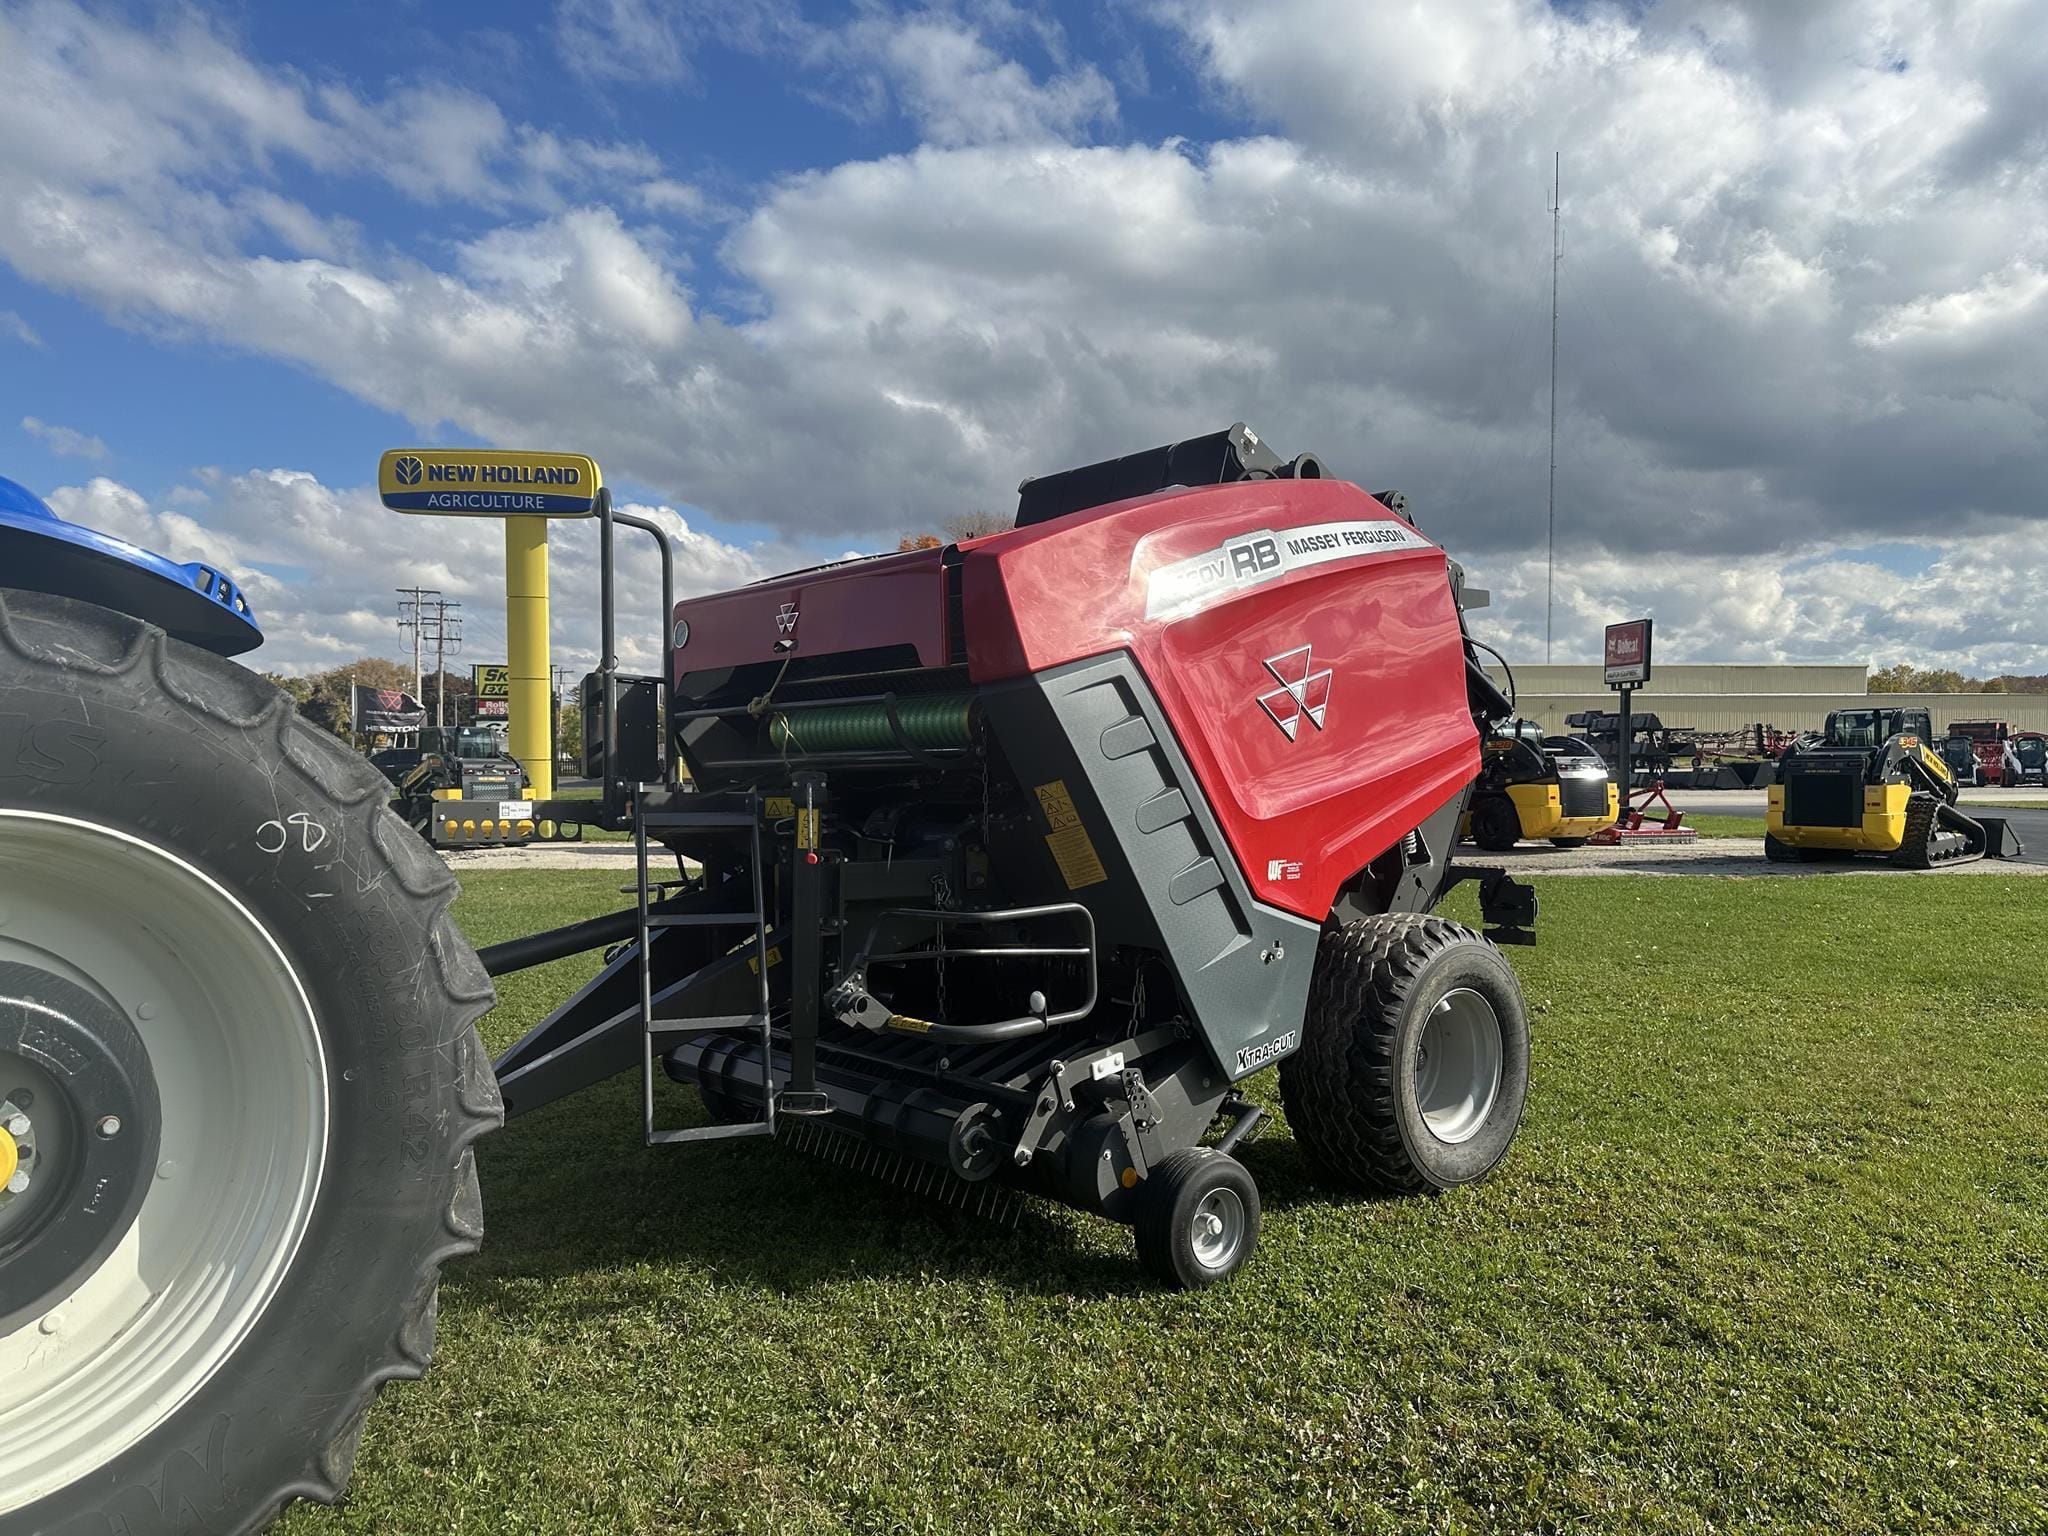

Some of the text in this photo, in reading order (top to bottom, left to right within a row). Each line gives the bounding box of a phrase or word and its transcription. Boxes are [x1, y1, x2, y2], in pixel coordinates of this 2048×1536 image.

[428, 464, 580, 485] NEW HOLLAND
[427, 494, 545, 509] AGRICULTURE
[1286, 529, 1407, 556] MASSEY FERGUSON
[1229, 538, 1281, 579] RB
[484, 669, 508, 682] SK
[484, 685, 508, 694] EXP
[1235, 1030, 1296, 1075] XTRA-CUT
